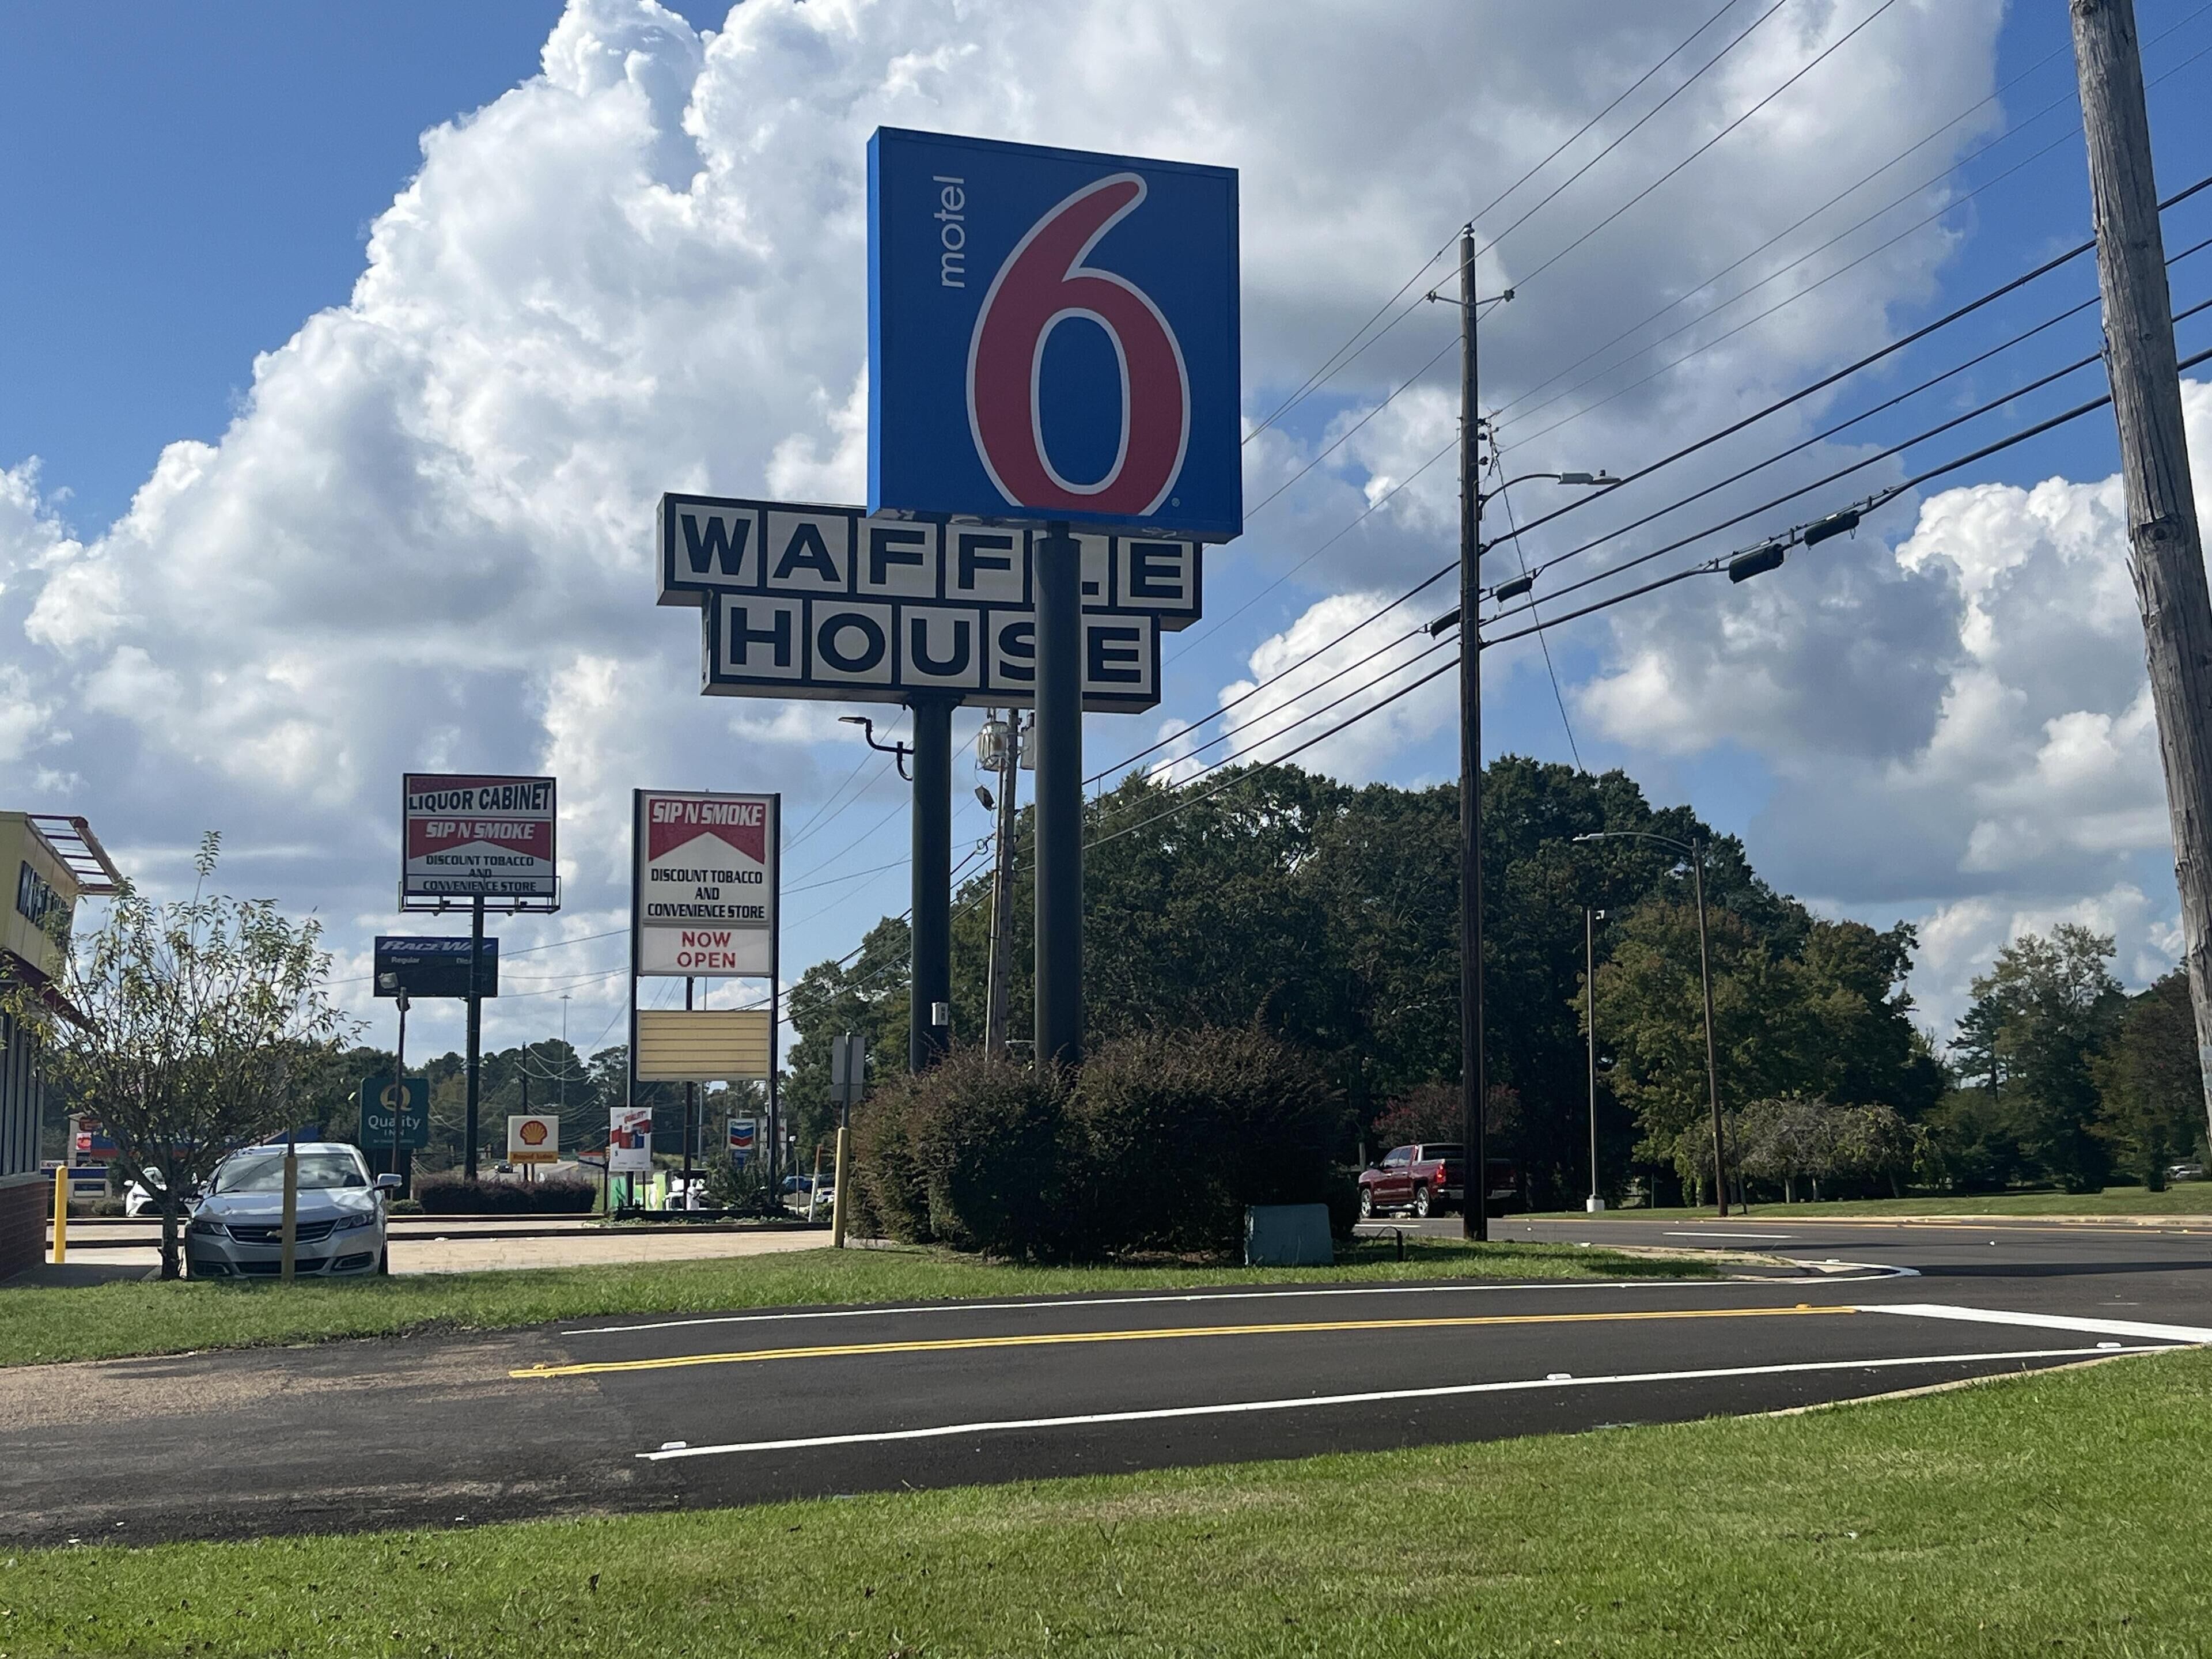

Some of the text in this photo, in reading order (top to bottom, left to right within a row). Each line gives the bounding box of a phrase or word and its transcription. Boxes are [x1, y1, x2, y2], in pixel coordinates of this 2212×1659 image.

[933, 175, 965, 288] motel
[966, 172, 1191, 516] 6
[680, 514, 1184, 599] WAFFE
[730, 607, 1142, 683] HOUSE
[408, 782, 552, 813] LIQUOR CABINET
[653, 802, 763, 827] SIP N SMOKE
[425, 821, 536, 840] SIP N SMOKE
[426, 855, 535, 867] DISCOUNT TOBACCO
[468, 868, 493, 878] AND
[651, 868, 763, 884] DISCOUNT TOBACCO
[423, 880, 537, 892] CONVENIENCE STORE
[695, 887, 720, 900] AND
[647, 903, 765, 919] CONVENIENCE STORE
[681, 931, 732, 948] NOW
[391, 956, 420, 964] Regular
[677, 951, 736, 968] OPEN
[368, 1115, 421, 1130] Quaity
